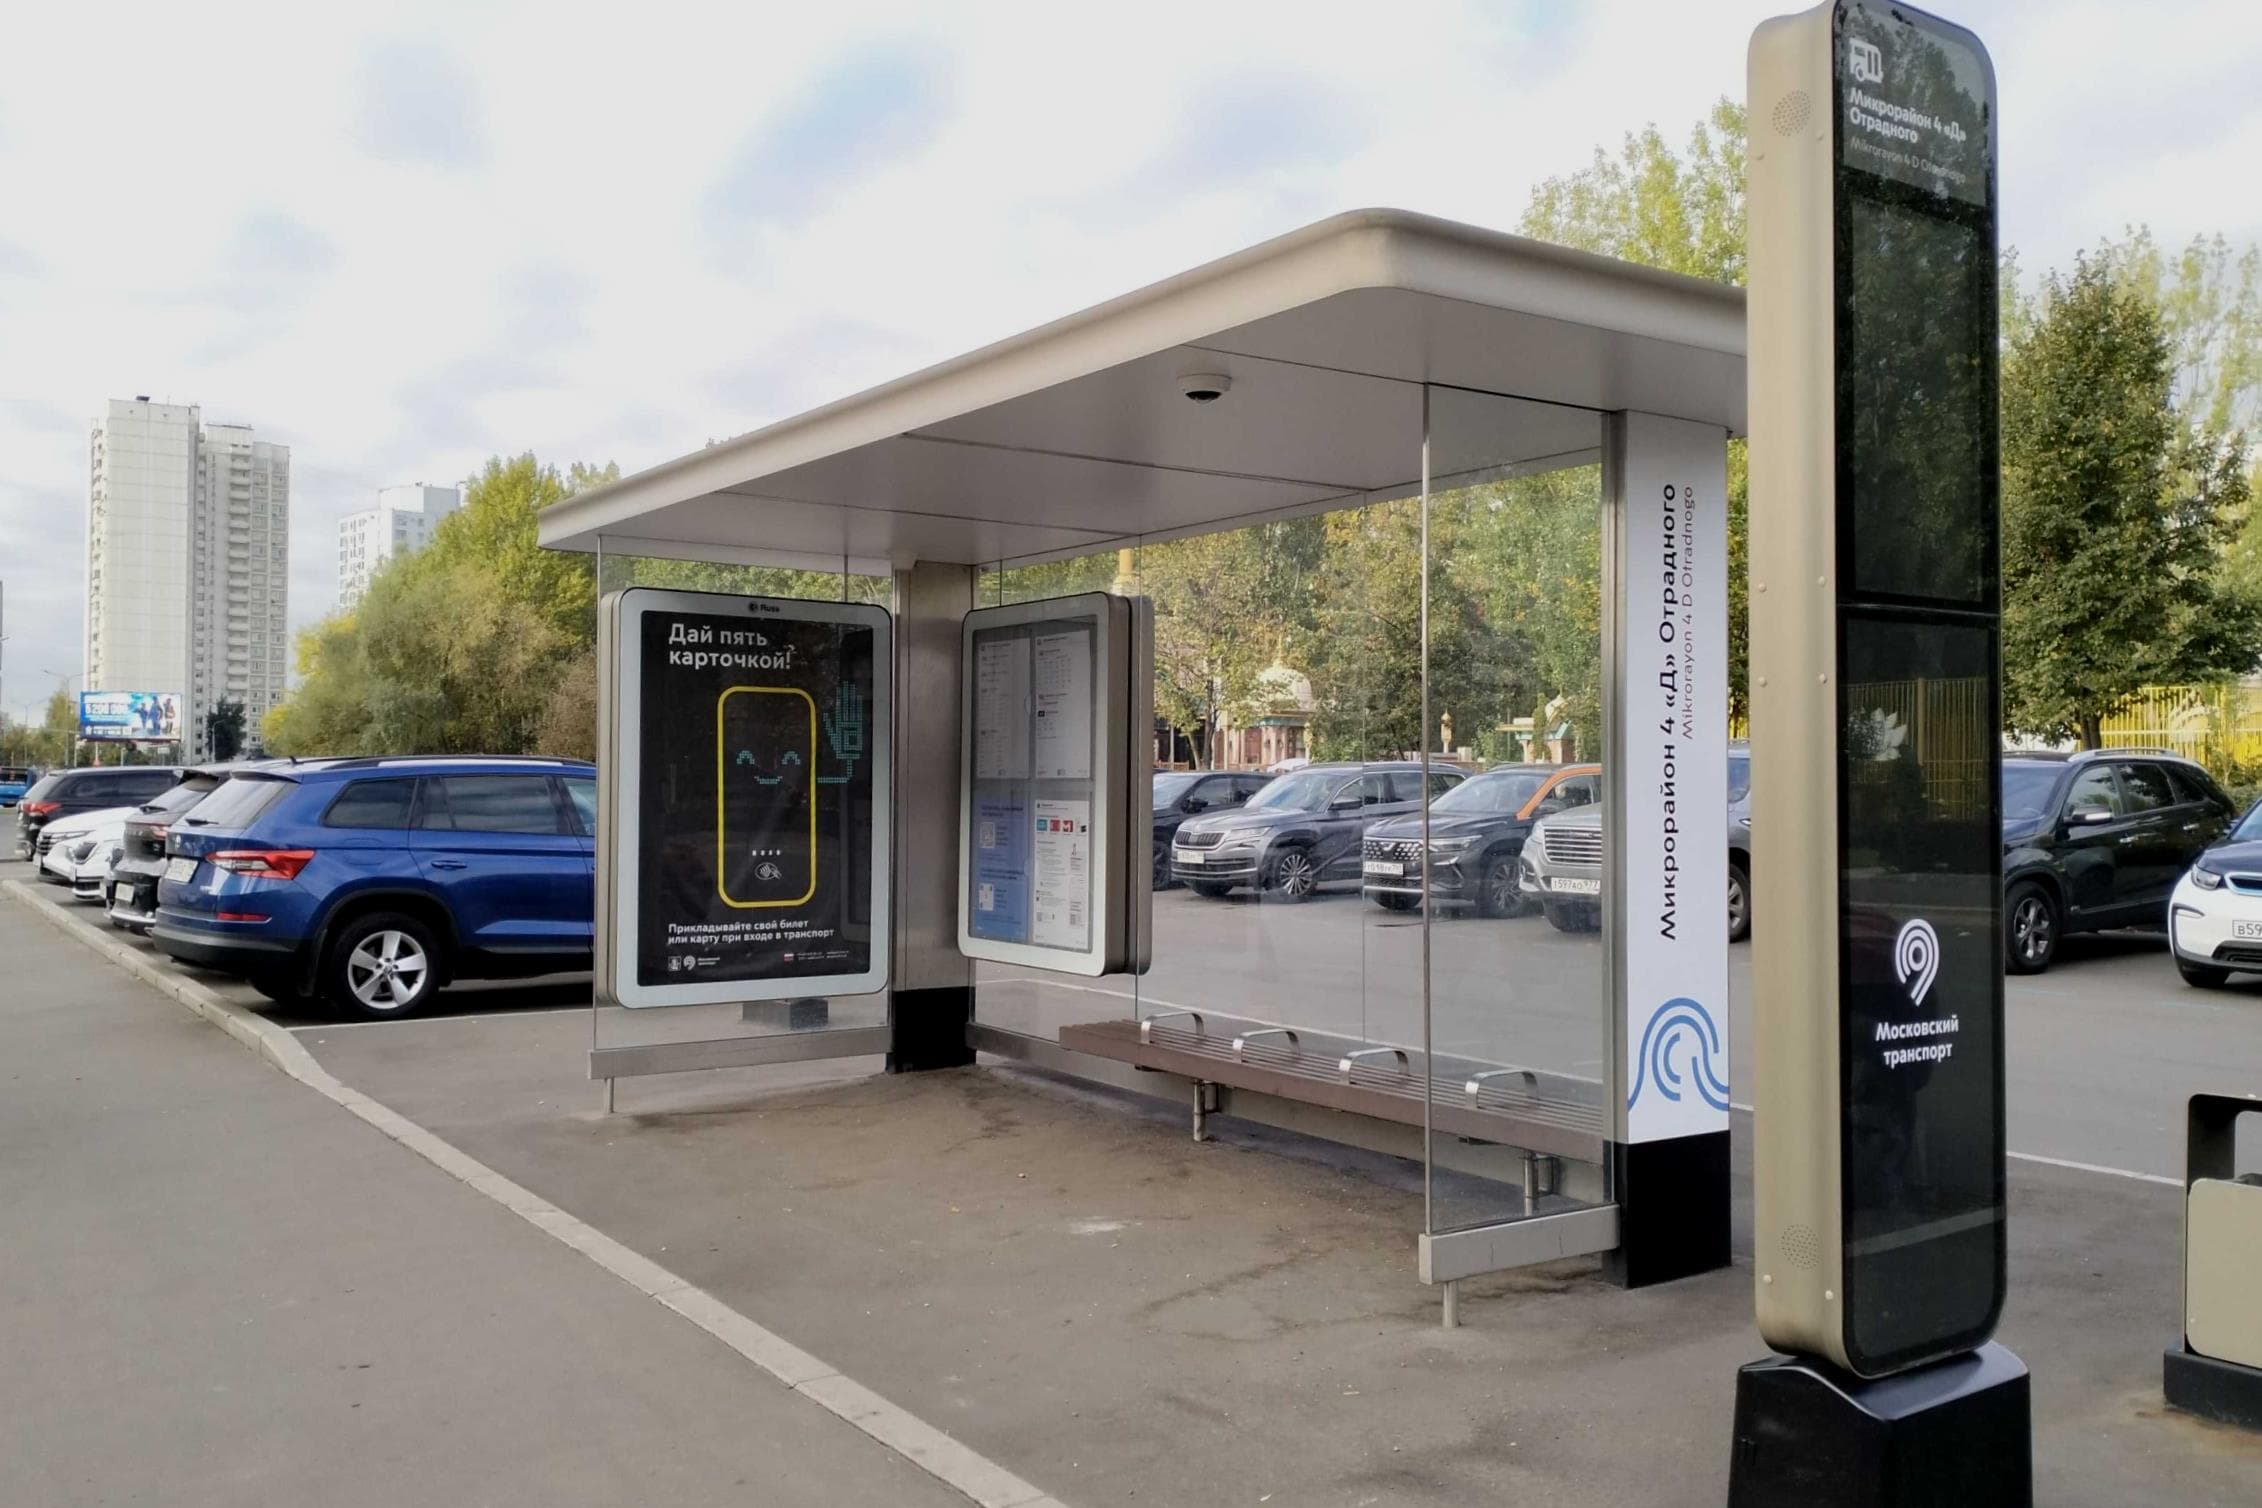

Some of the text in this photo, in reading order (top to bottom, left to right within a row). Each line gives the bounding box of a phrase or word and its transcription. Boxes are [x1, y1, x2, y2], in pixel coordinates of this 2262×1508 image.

[1850, 87, 1967, 142] Микрорайон 4 «Д»
[1850, 106, 1918, 143] Отрадного
[1681, 486, 1695, 740] Mikrorayon 4 D Otradnogo
[668, 623, 768, 647] Дай пять
[669, 650, 791, 671] карточкой!
[1659, 484, 1679, 941] Микрорайон 4 «Д» Отрадного
[668, 919, 809, 934] Прикладывайте свой билет
[668, 935, 688, 945] или
[690, 934, 719, 945] карту
[722, 933, 742, 944] при
[743, 932, 773, 941] входе
[783, 929, 835, 940] транспорт
[1876, 1014, 1959, 1041] Московский
[1883, 1044, 1953, 1069] транспорт
